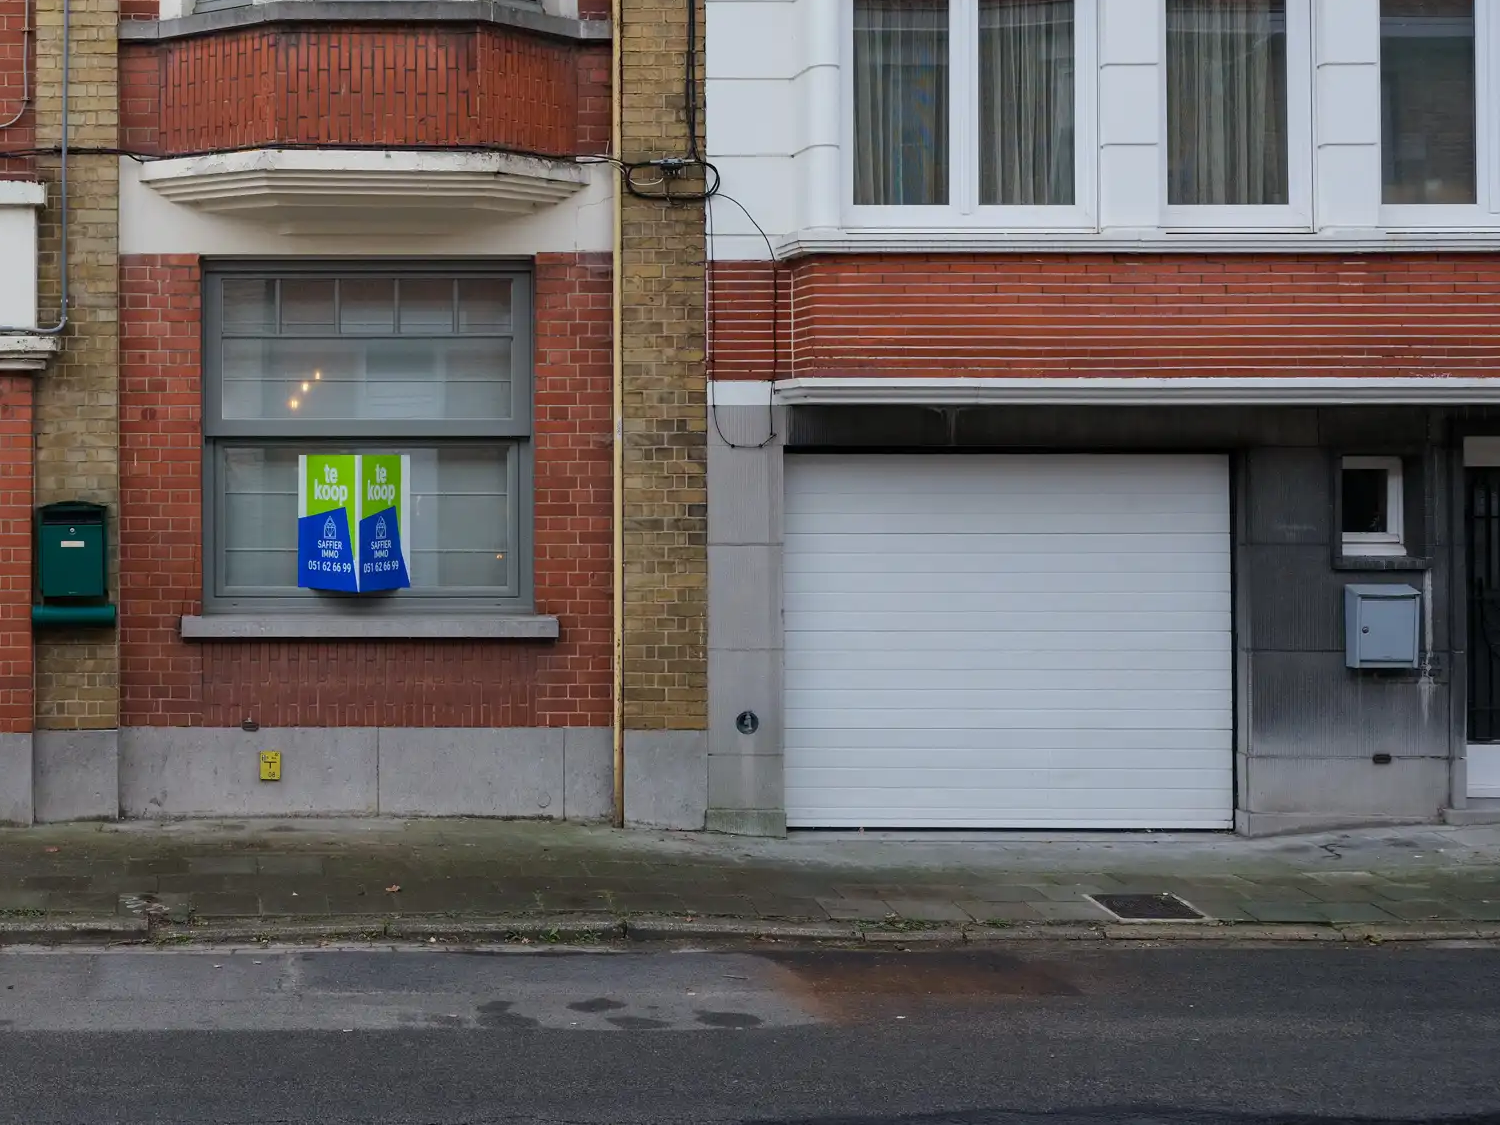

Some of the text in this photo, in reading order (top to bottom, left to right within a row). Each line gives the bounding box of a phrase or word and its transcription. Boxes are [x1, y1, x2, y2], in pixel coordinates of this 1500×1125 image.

[324, 463, 338, 483] te
[375, 463, 387, 483] te
[314, 478, 348, 506] koop
[367, 479, 395, 506] koop
[318, 540, 342, 550] SAFFIER
[371, 540, 392, 550] SAFFIER
[321, 550, 339, 558] IMMO
[374, 550, 389, 559] IMMO
[308, 560, 351, 573] 051 62 66 99
[364, 560, 399, 573] 051 62 66 99
